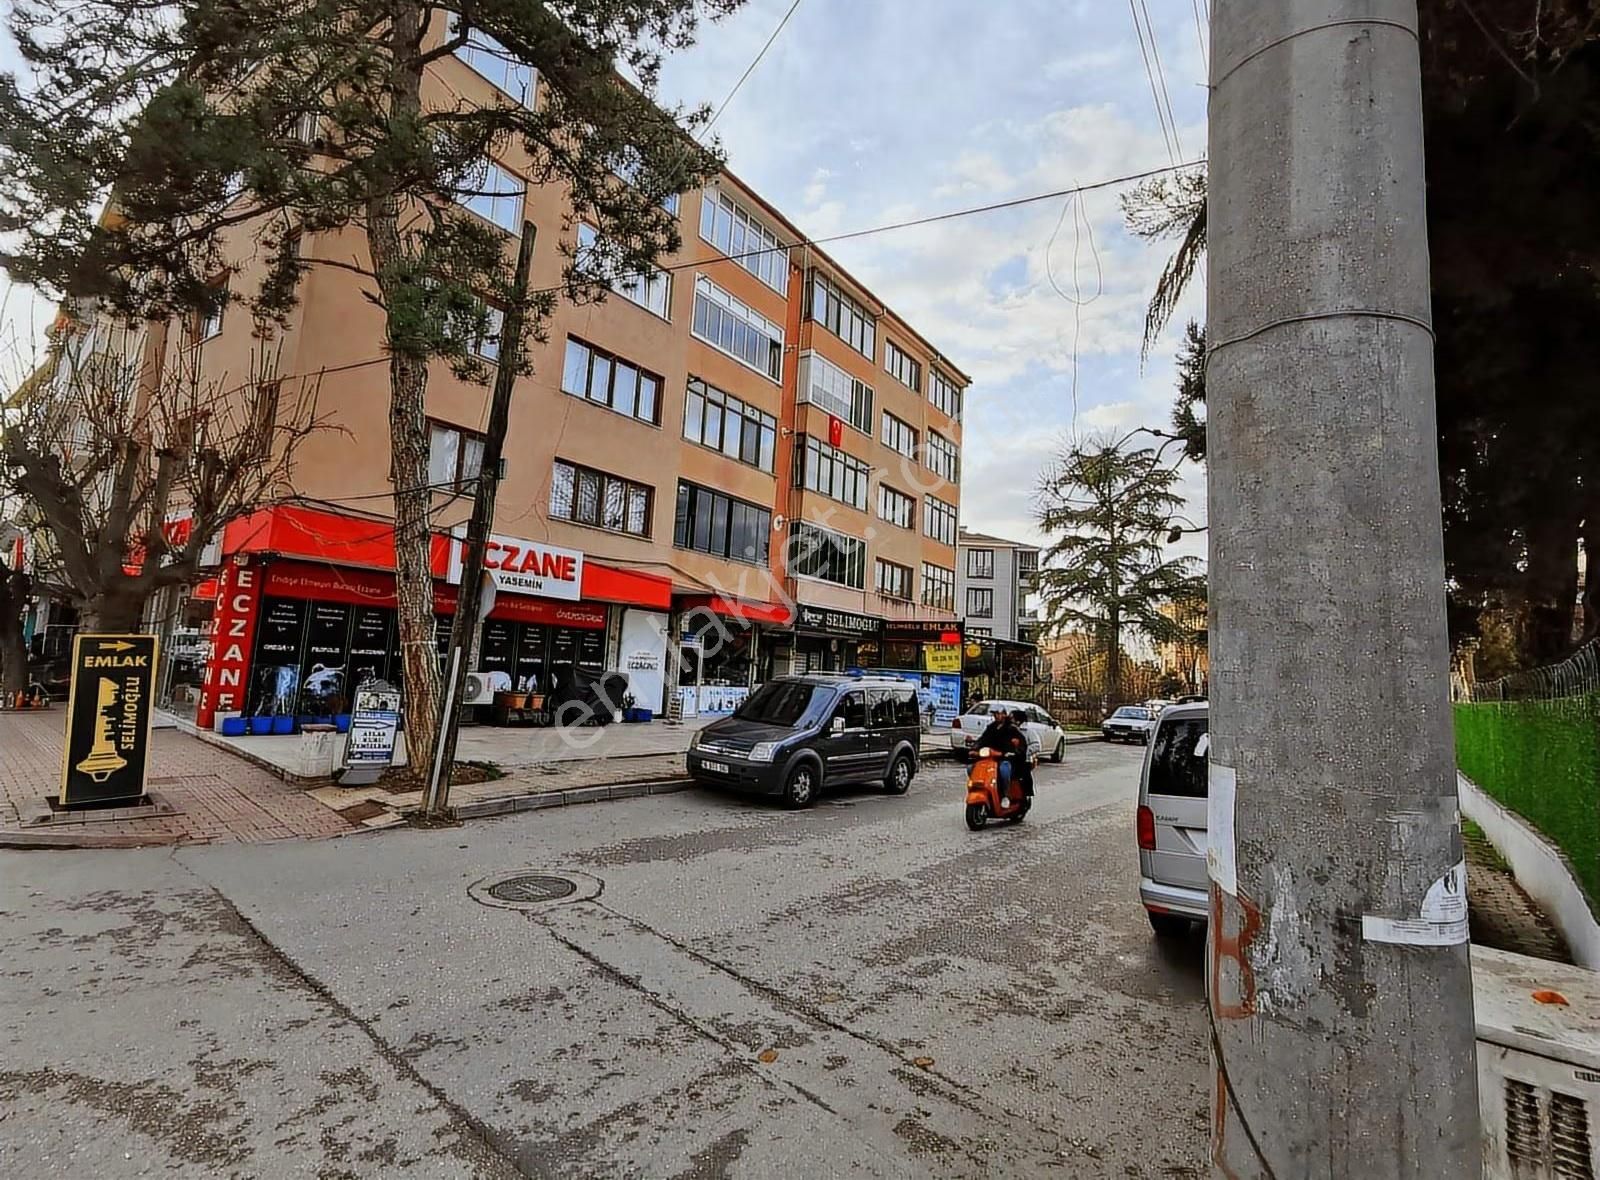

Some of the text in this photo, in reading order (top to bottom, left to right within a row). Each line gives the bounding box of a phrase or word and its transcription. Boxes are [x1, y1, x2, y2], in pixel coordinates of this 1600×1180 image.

[499, 575, 543, 589] YASEMİN
[200, 568, 229, 710] ECZANE
[218, 570, 253, 711] ECZANE
[922, 623, 958, 631] EMLAK
[84, 655, 148, 668] EMLAK
[118, 676, 141, 750] SELİMOĞLU
